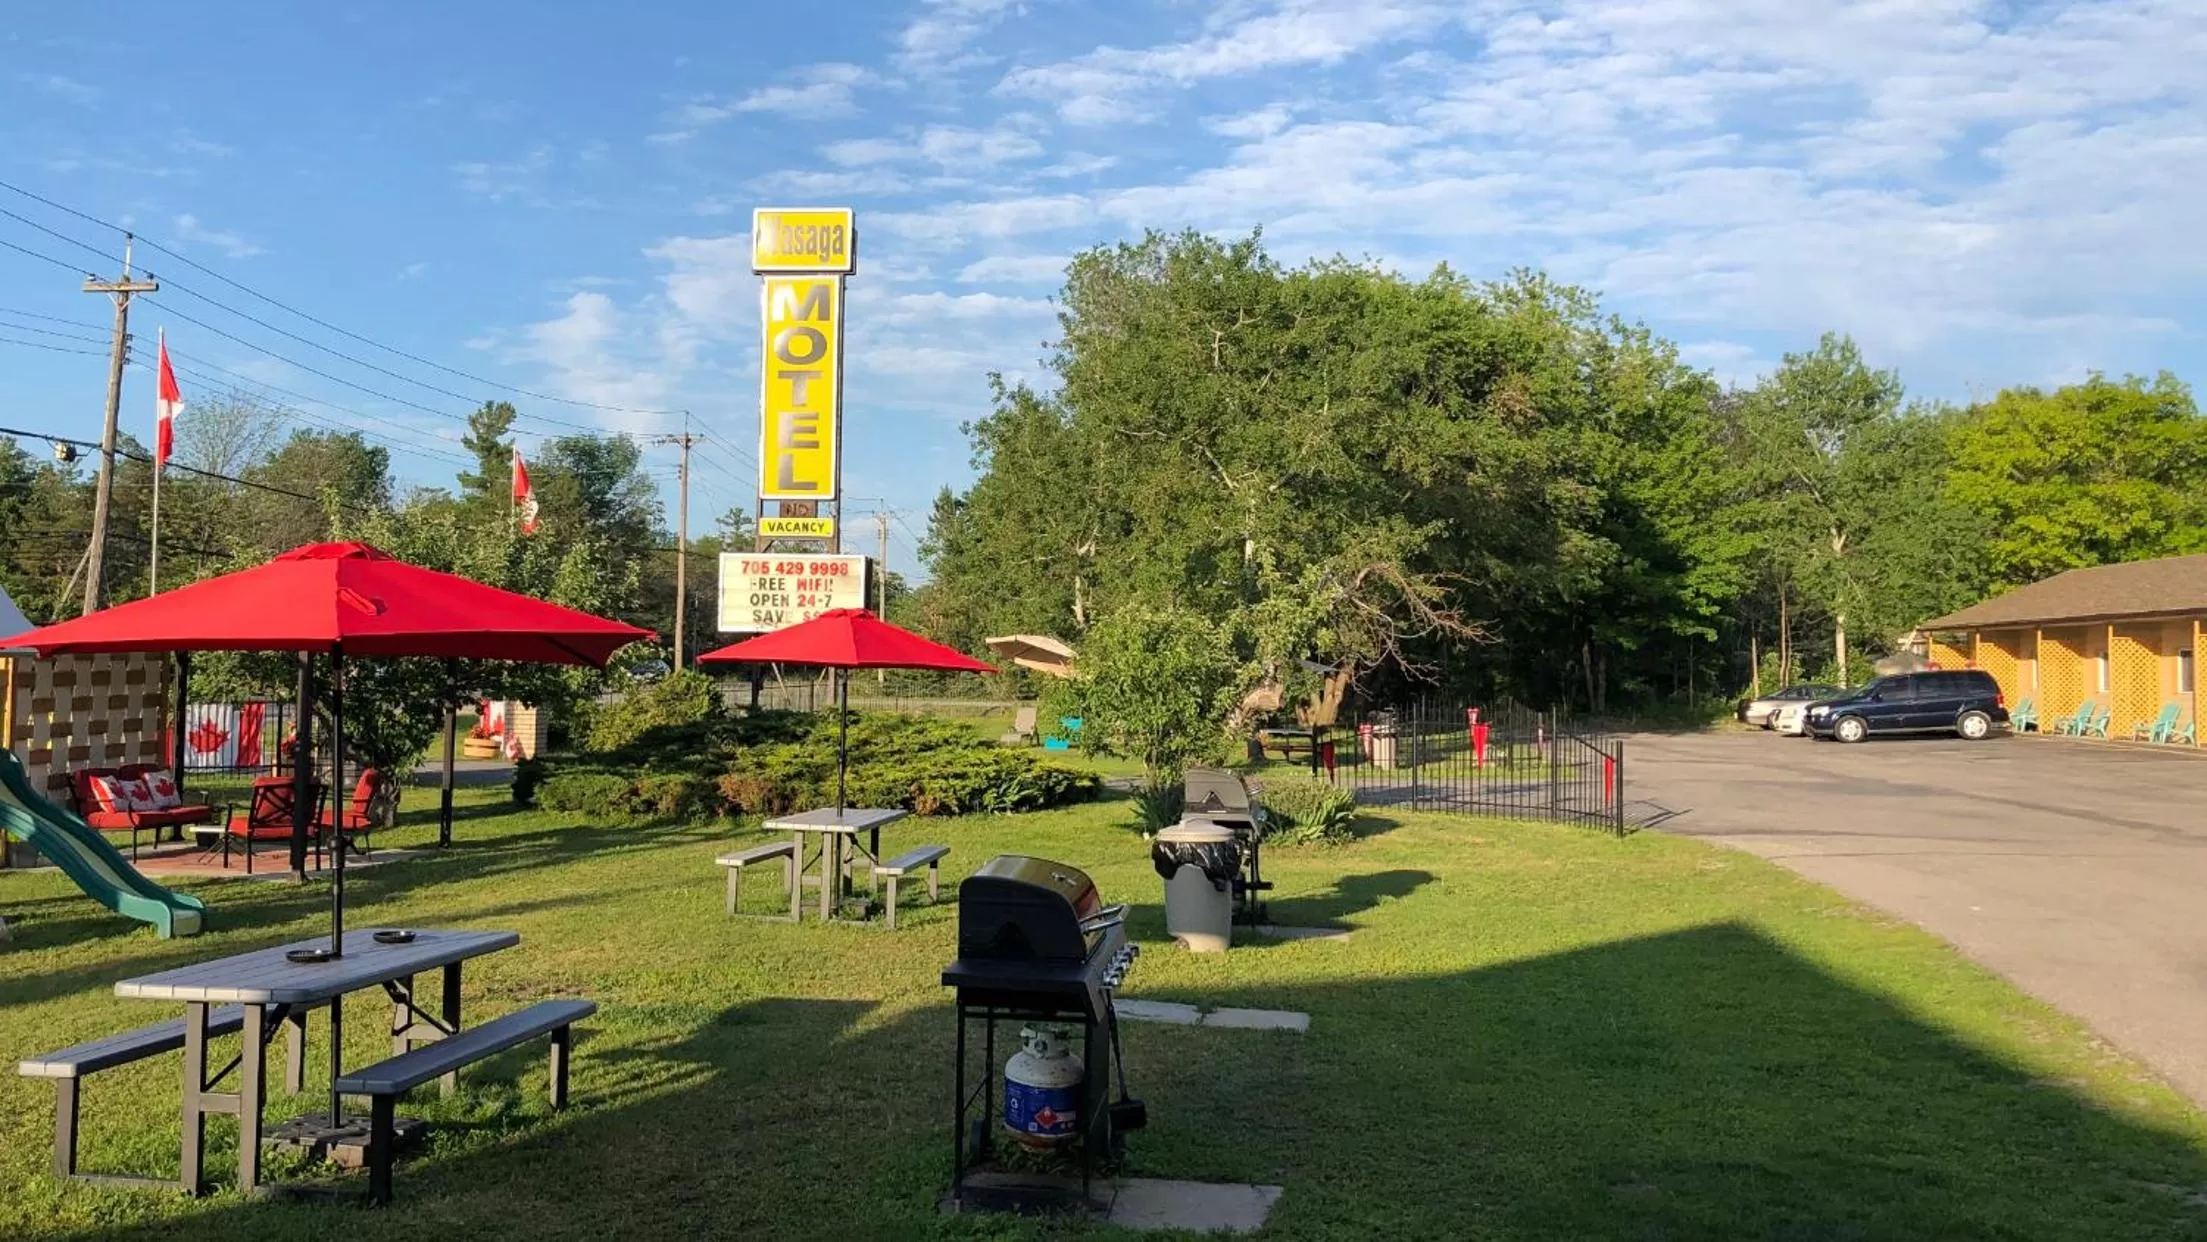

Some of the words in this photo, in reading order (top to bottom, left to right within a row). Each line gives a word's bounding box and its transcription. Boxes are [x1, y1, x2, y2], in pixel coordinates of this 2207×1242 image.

[772, 284, 831, 490] MOTEL
[767, 522, 825, 533] VACANCY
[741, 561, 769, 574] 705
[775, 562, 804, 575] 429
[810, 563, 848, 576] 9998
[750, 593, 789, 606] OPEN
[797, 594, 832, 607] 24-7
